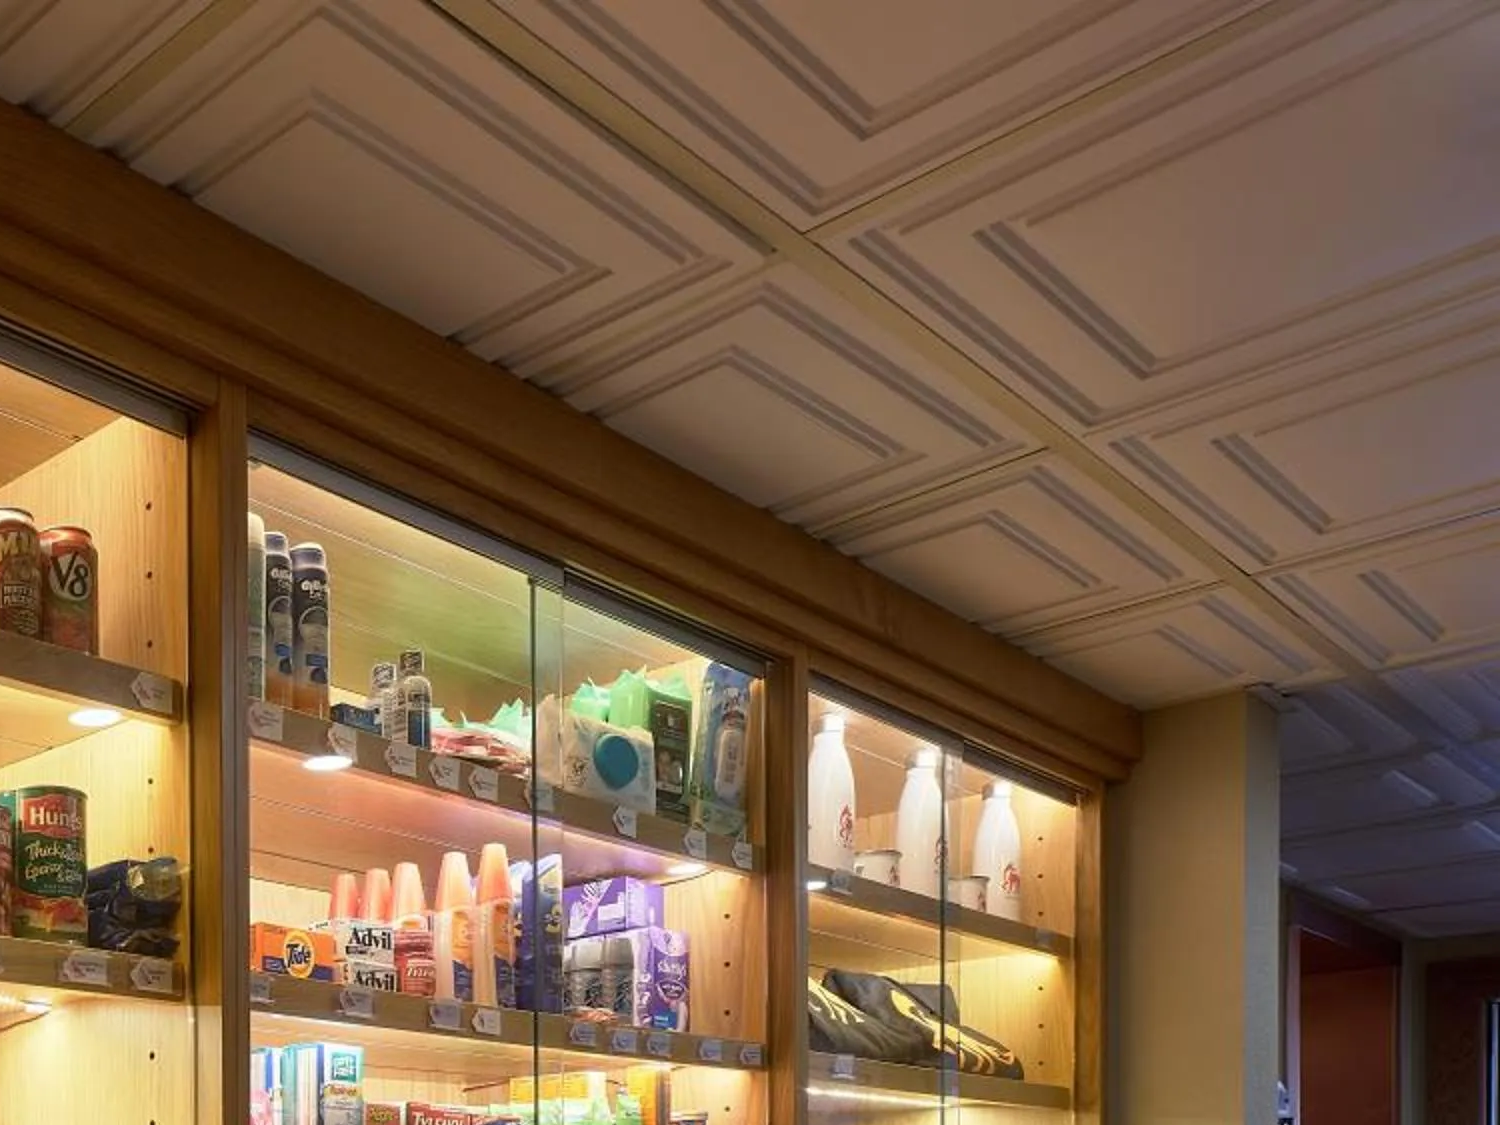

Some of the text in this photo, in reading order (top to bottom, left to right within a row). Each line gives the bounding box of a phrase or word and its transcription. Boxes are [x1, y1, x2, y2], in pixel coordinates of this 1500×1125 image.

[50, 551, 90, 597] V8
[348, 927, 393, 951] Advil
[353, 970, 395, 992] Advil
